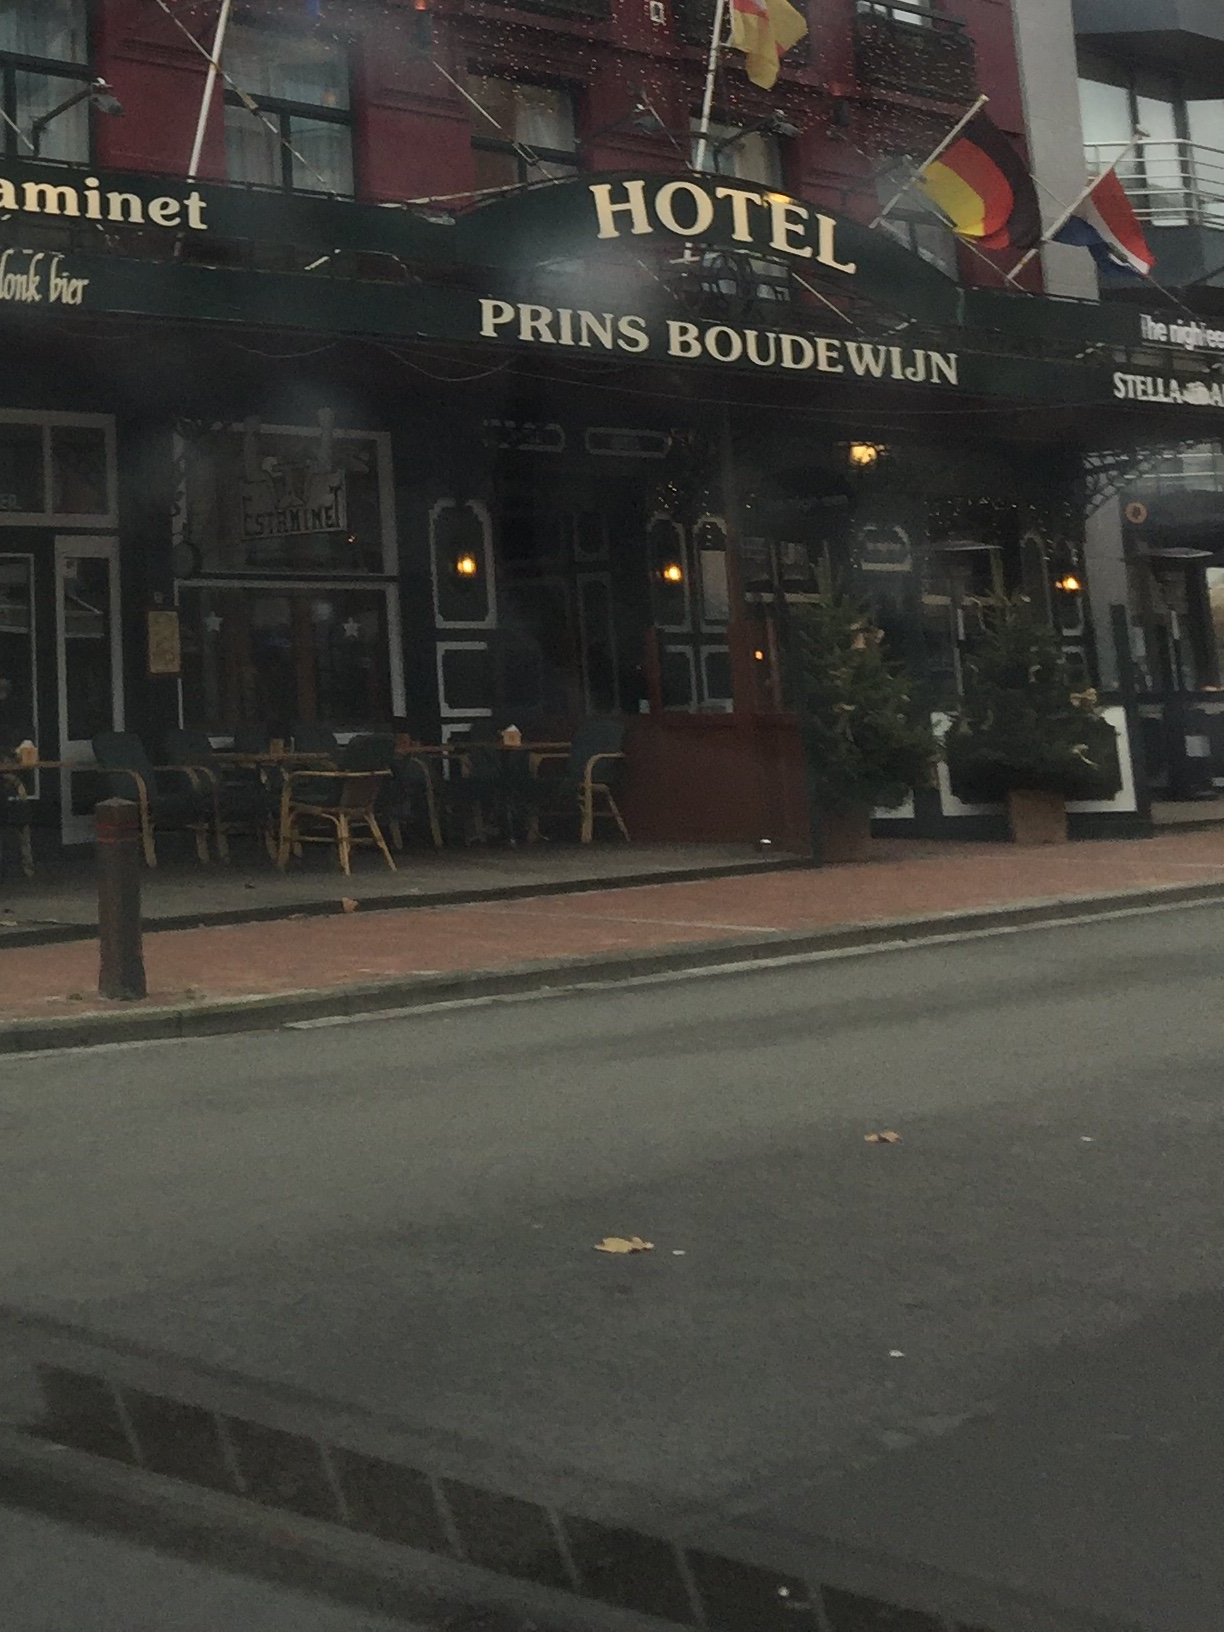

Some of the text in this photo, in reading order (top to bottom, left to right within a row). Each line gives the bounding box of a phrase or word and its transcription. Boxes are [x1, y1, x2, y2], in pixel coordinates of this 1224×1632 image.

[588, 179, 858, 275] HOTEL
[48, 254, 90, 305] bier
[478, 297, 959, 385] PRINS BOUDEWIJN
[1113, 371, 1184, 404] STELLA
